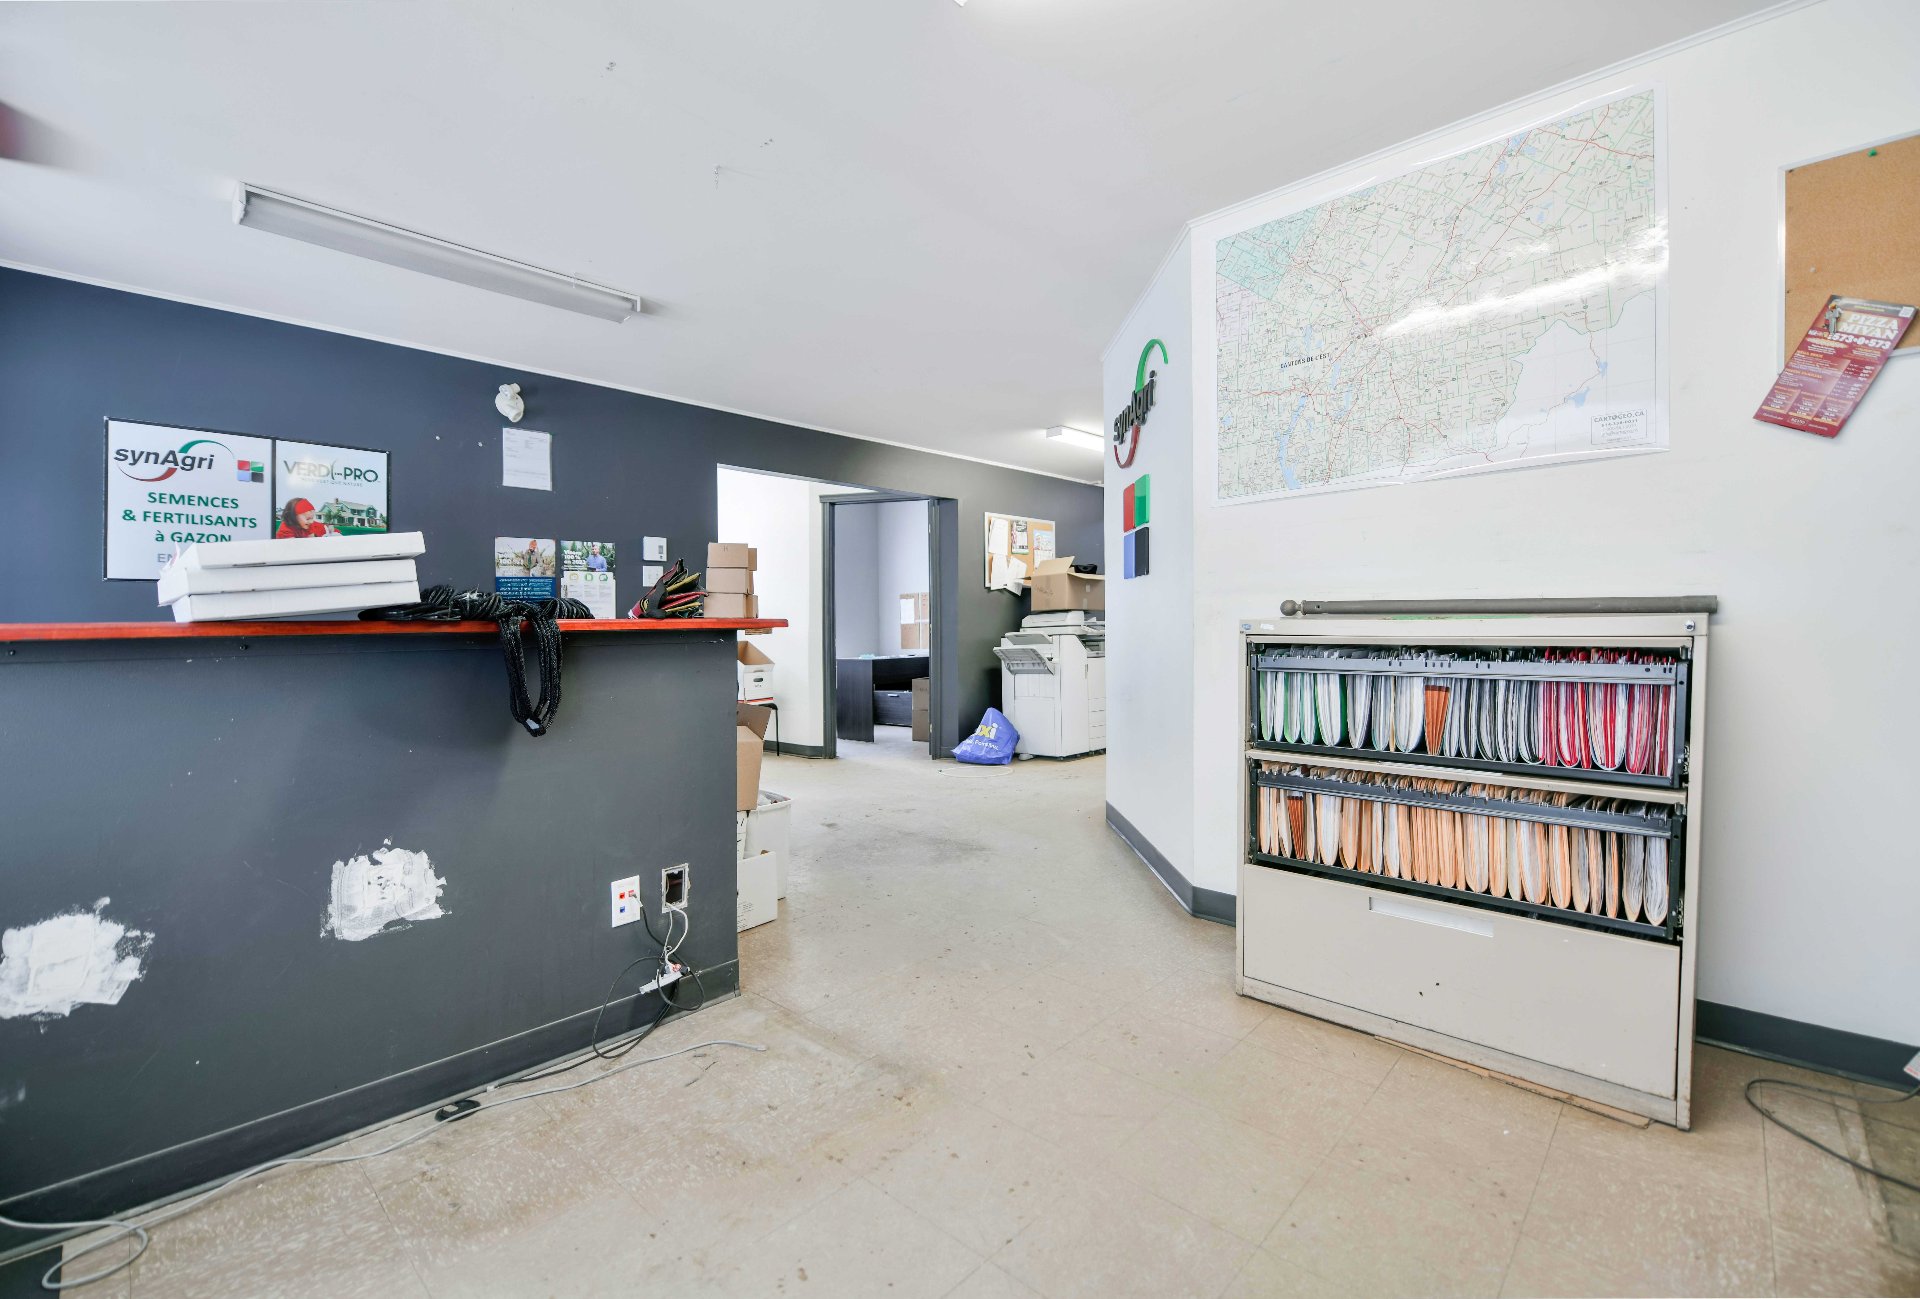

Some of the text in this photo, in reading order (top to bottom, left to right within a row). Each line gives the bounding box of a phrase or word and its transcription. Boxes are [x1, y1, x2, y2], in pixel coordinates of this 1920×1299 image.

[1847, 312, 1899, 330] PIZZA
[1112, 369, 1156, 446] synAgri
[113, 448, 215, 472] synAgri
[147, 491, 239, 509] SEMENCES
[122, 509, 257, 528] & FERTILISANTS
[155, 530, 231, 543] à GAZON
